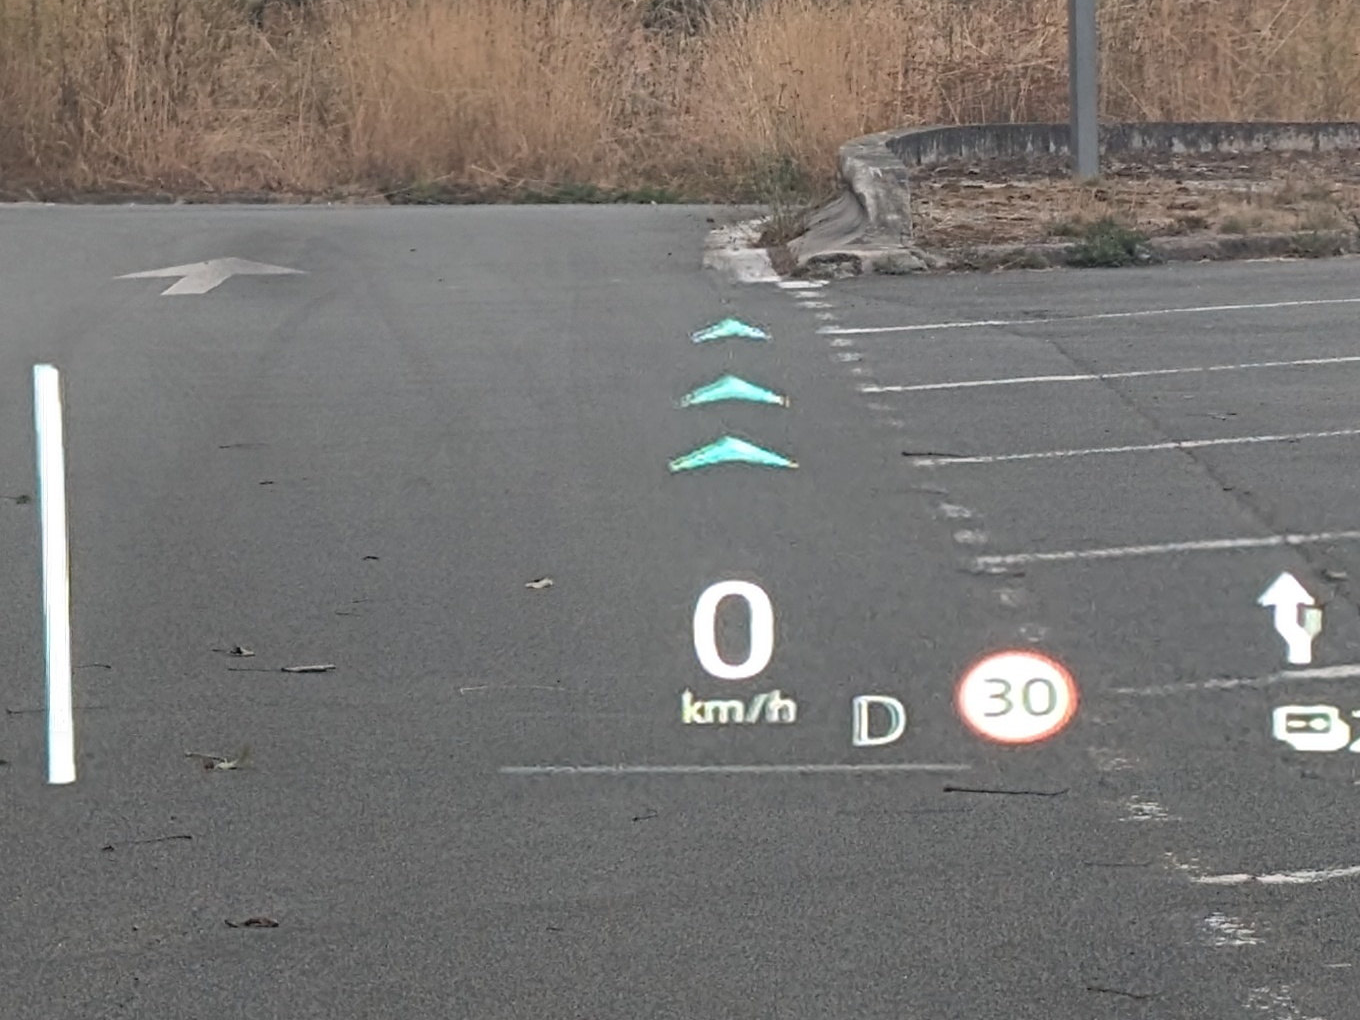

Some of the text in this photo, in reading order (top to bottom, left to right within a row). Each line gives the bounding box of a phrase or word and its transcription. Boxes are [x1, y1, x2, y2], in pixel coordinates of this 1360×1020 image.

[693, 580, 775, 680] 0
[681, 689, 797, 724] km/h
[982, 676, 1059, 718] 30
[852, 695, 907, 746] D
